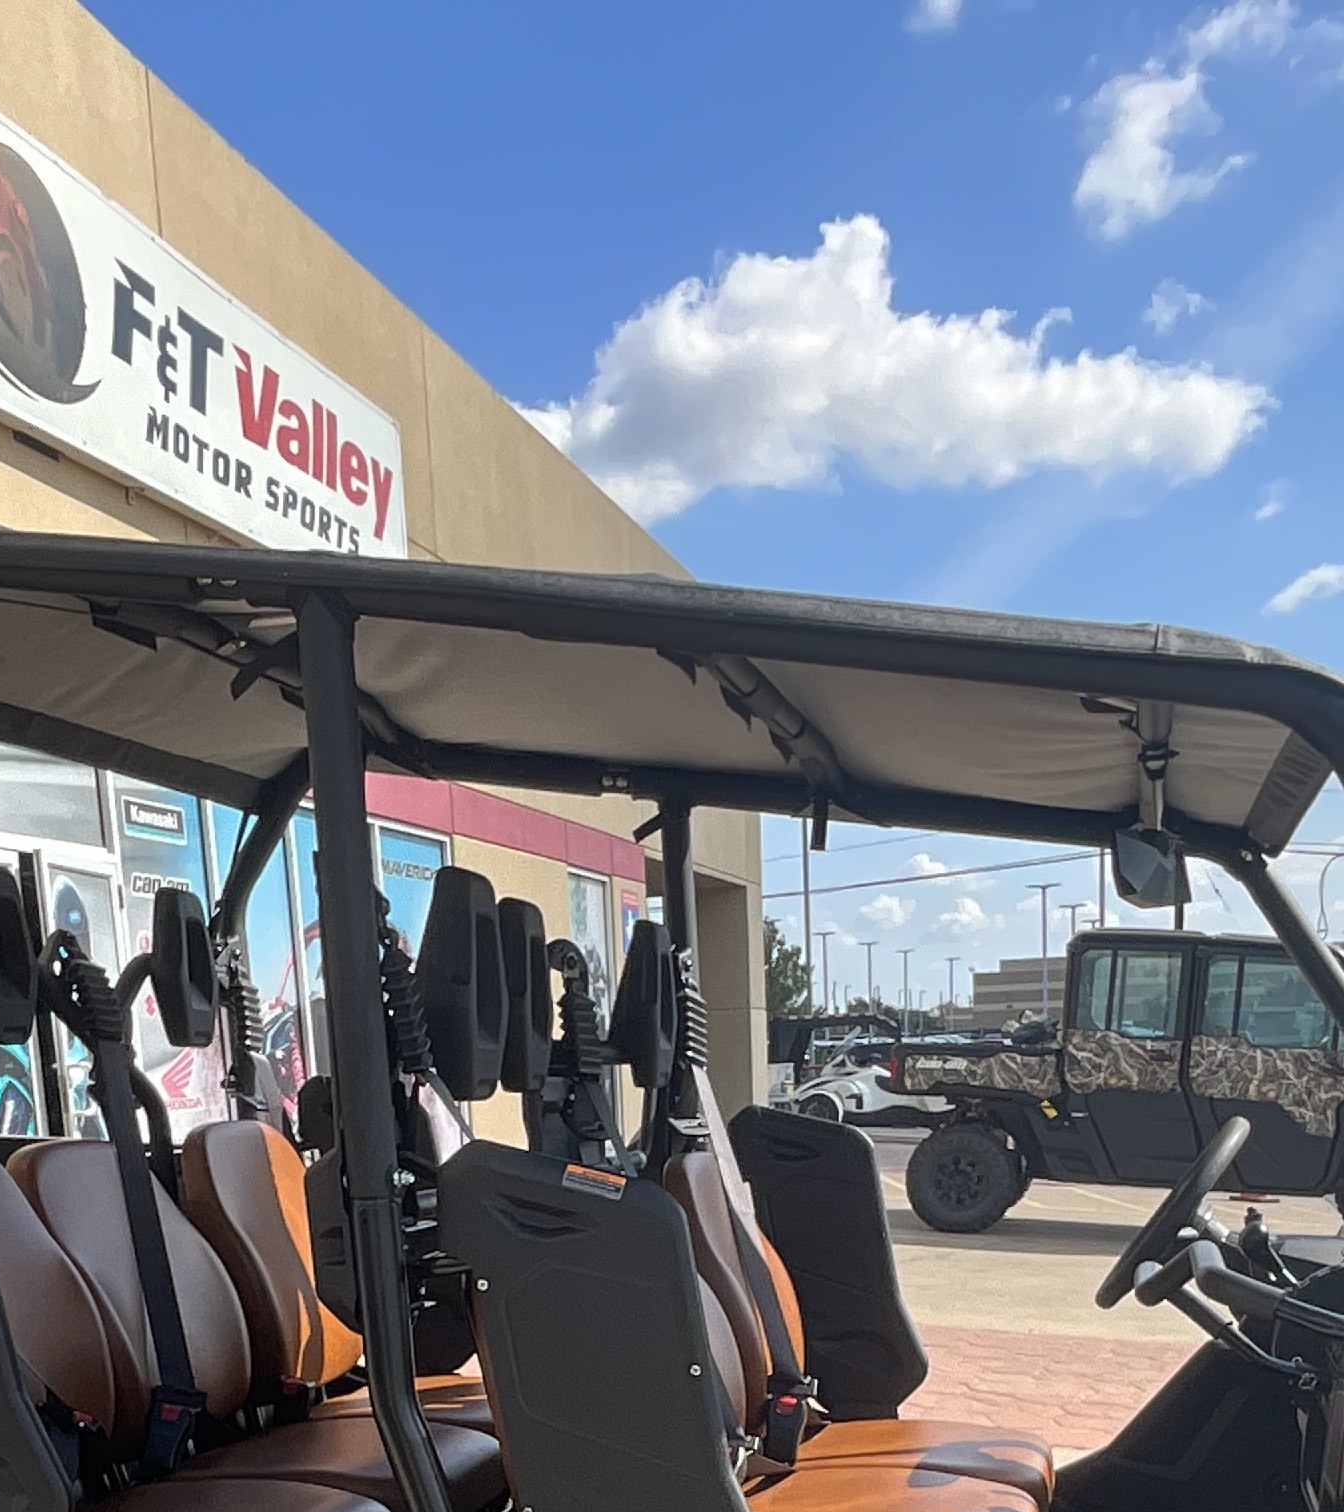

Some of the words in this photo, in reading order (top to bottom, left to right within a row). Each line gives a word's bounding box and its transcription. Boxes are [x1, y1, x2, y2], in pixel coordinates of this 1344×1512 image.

[111, 257, 224, 417] F&T
[231, 342, 393, 541] Valley
[145, 405, 253, 500] MOTOR
[264, 475, 360, 555] SPORTS
[129, 804, 179, 830] Kawasaki
[380, 858, 436, 881] MAVERIC
